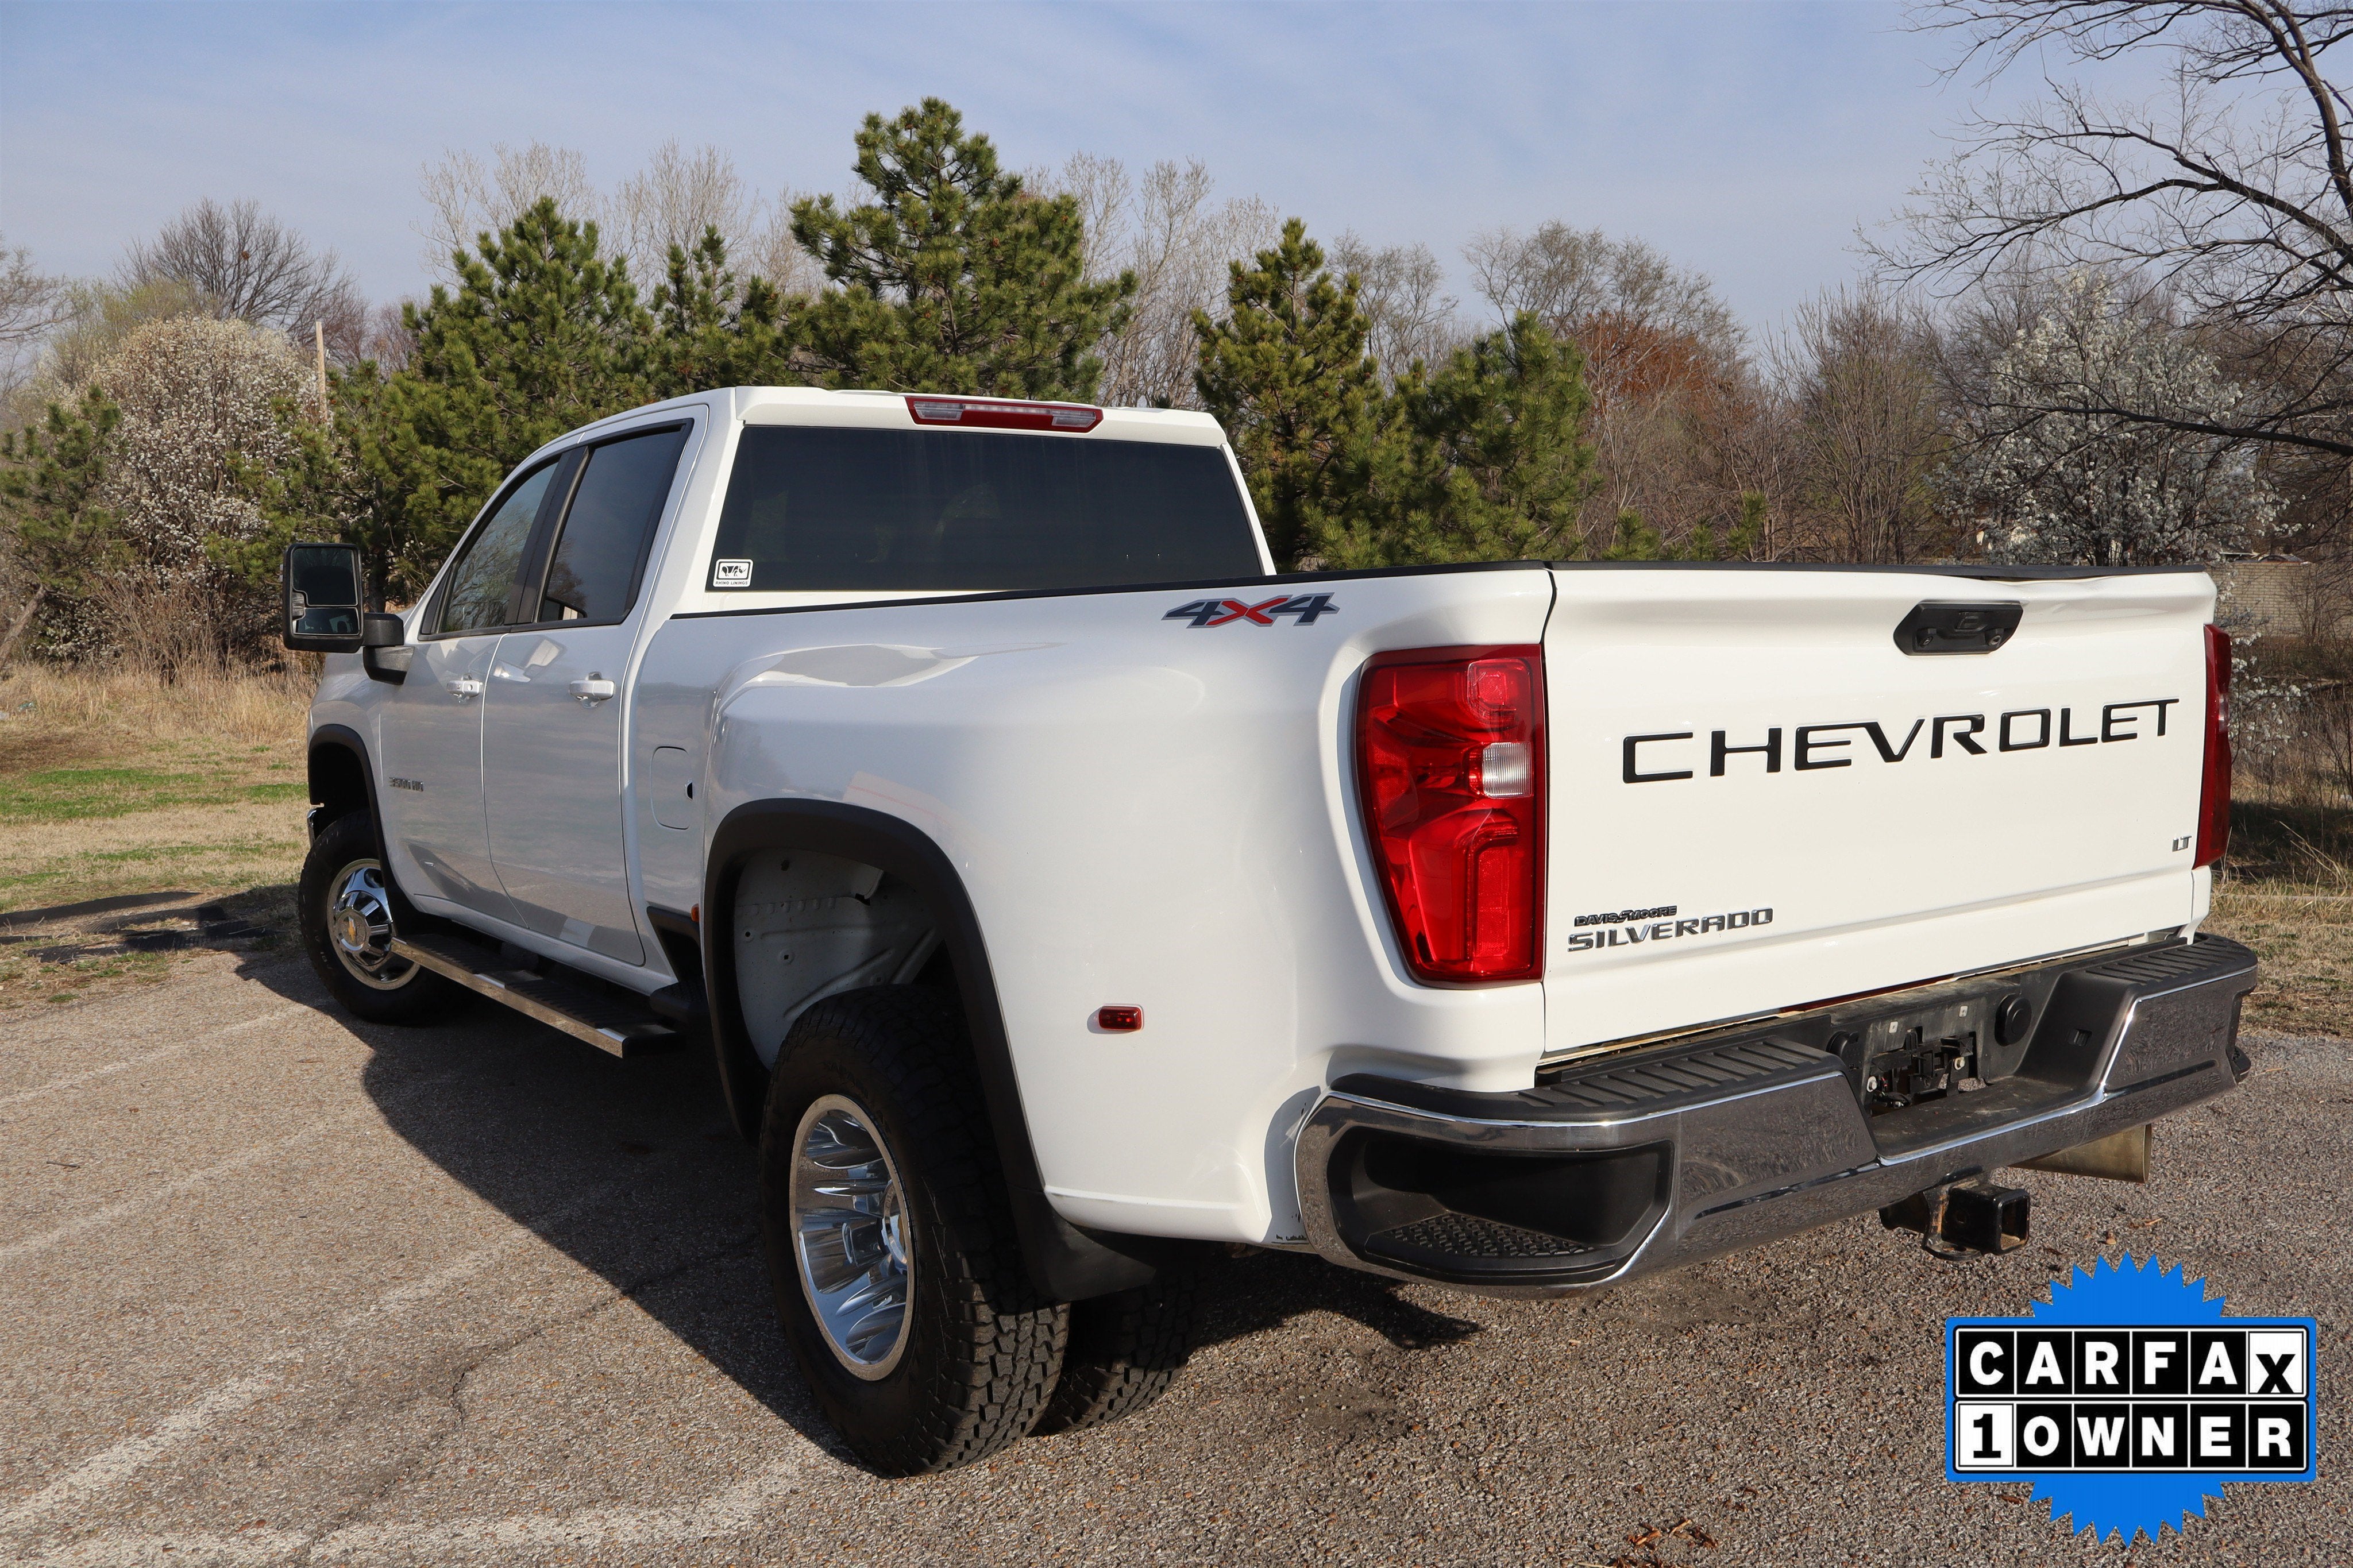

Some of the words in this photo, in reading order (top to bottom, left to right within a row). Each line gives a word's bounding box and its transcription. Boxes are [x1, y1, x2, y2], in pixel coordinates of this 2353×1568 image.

[1622, 698, 2180, 784] CHEVROLET
[2171, 835, 2192, 852] LT
[1567, 906, 1773, 952] SILVERADO
